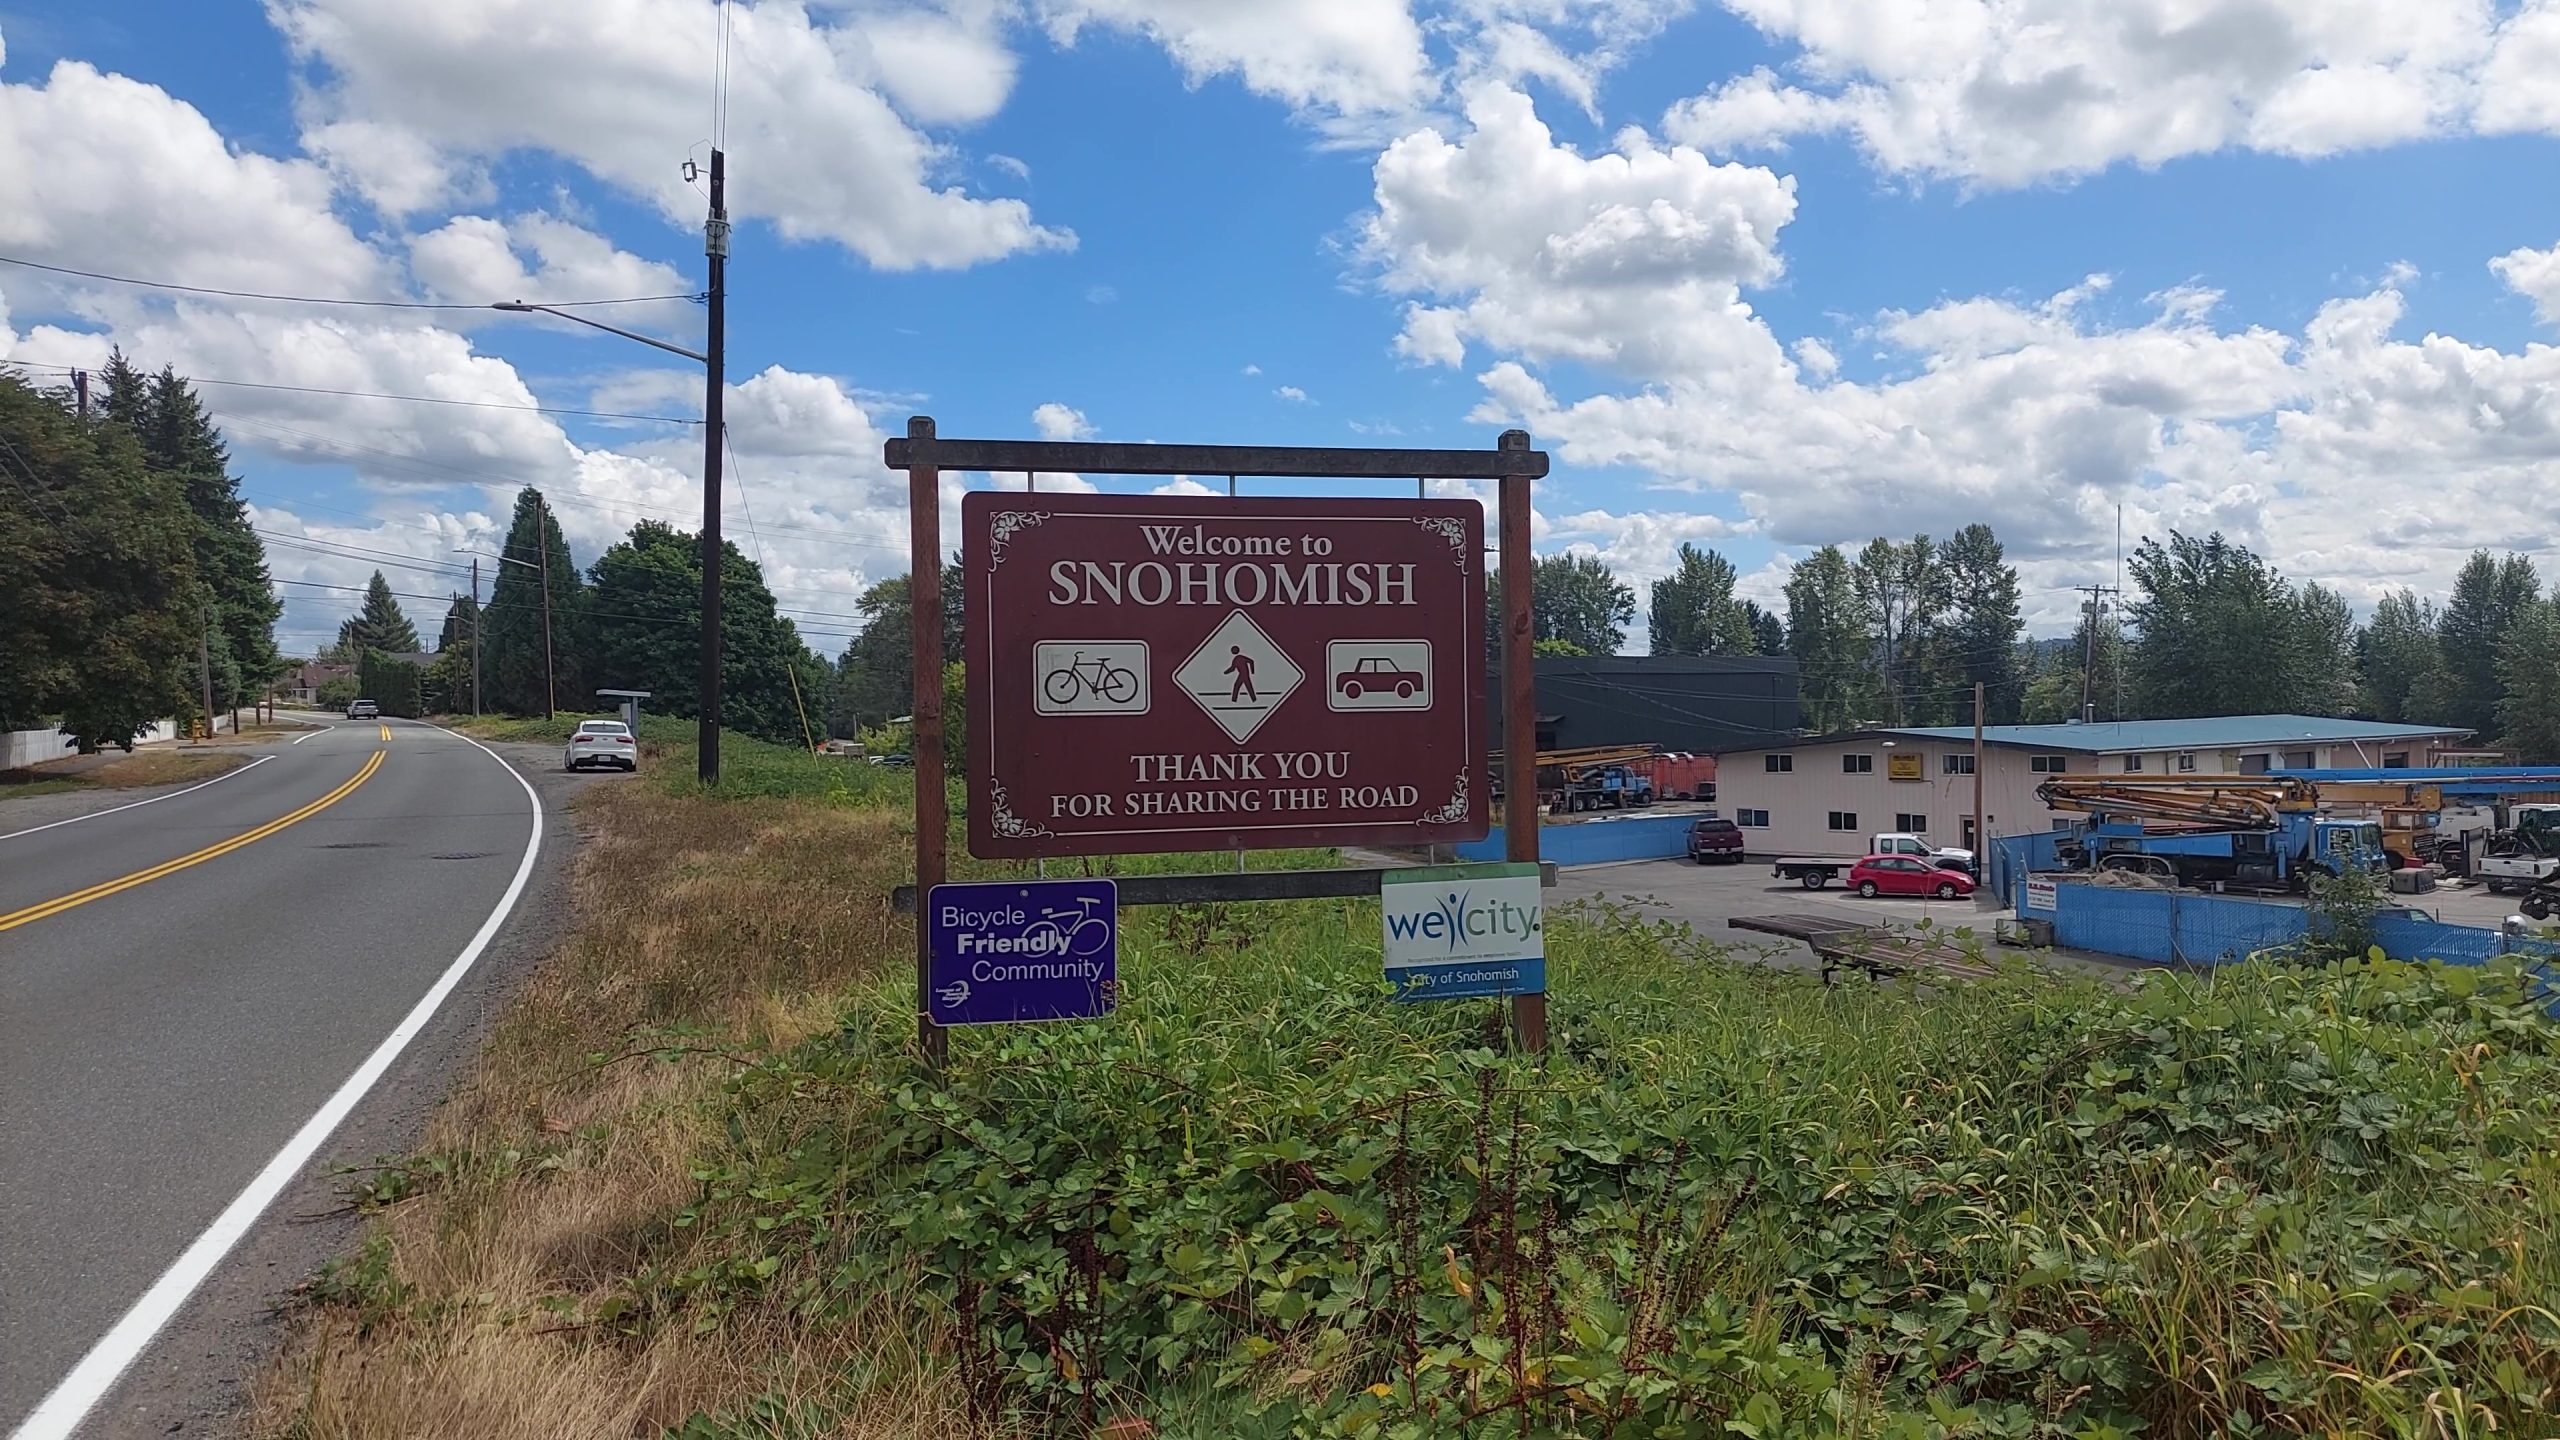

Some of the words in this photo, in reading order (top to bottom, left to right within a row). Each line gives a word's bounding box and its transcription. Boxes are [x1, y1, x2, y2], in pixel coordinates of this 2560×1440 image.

[1140, 525, 1291, 556] Welcome
[1302, 533, 1333, 556] to
[1048, 560, 1418, 606] SNOHOMISH
[1130, 753, 1266, 782] THANK
[1273, 751, 1351, 779] YOU
[1050, 793, 1115, 818] FOR
[1124, 790, 1261, 817] SHARING
[1269, 787, 1329, 811] THE
[1338, 785, 1419, 809] ROAD
[941, 904, 1026, 932] Bicycle
[957, 930, 1073, 956] Friendly
[971, 958, 1105, 983] Community
[1440, 972, 1454, 984] of
[1456, 967, 1519, 983] Snohomish
